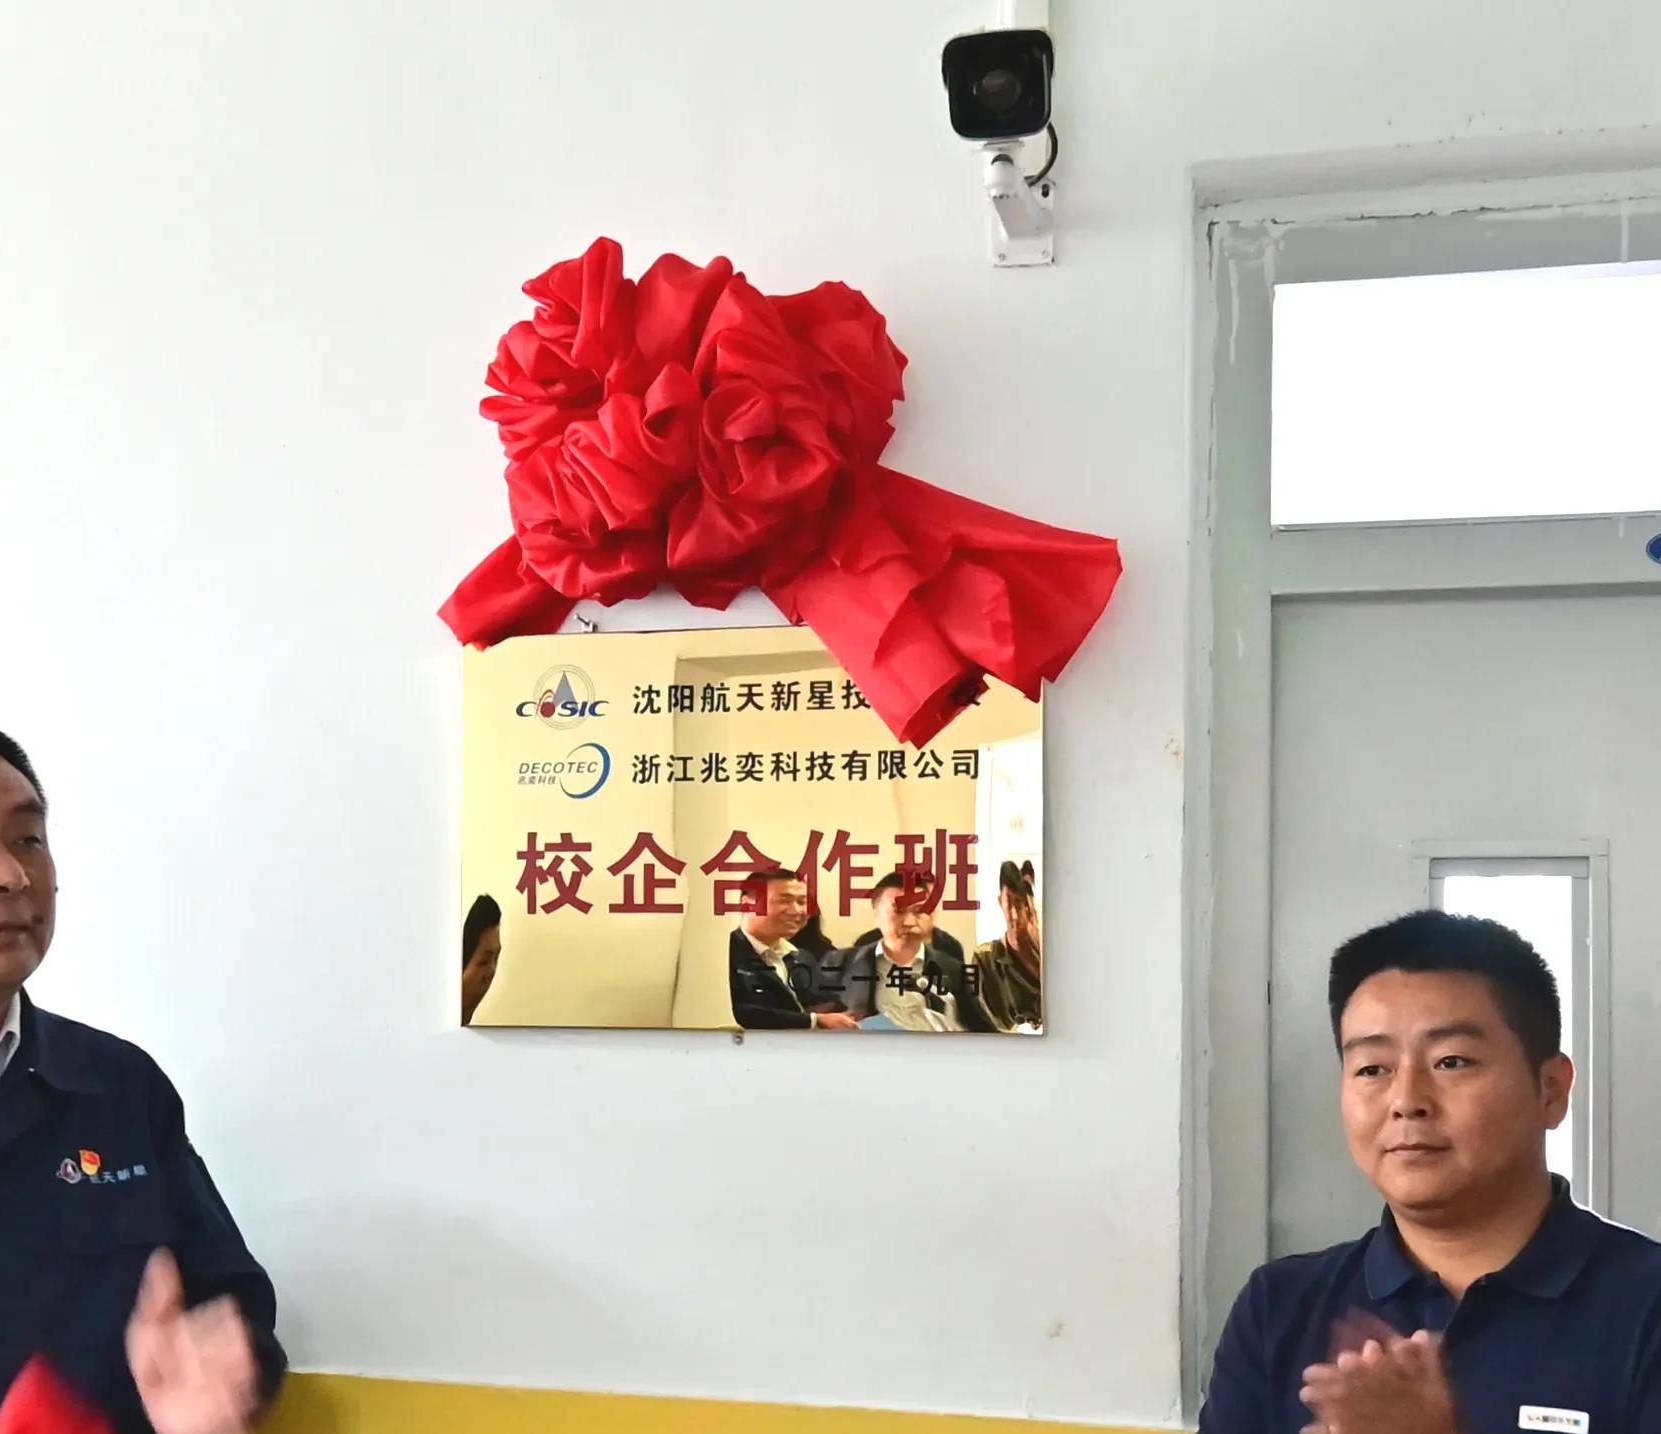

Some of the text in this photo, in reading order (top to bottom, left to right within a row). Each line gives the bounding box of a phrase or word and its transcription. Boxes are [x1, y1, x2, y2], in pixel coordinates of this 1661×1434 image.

[633, 679, 980, 715] 沈阳航天新星技
[518, 761, 599, 775] DECOTEC
[632, 747, 979, 785] 浙江兆奕科技有限公司
[516, 828, 981, 917] 校企合作班
